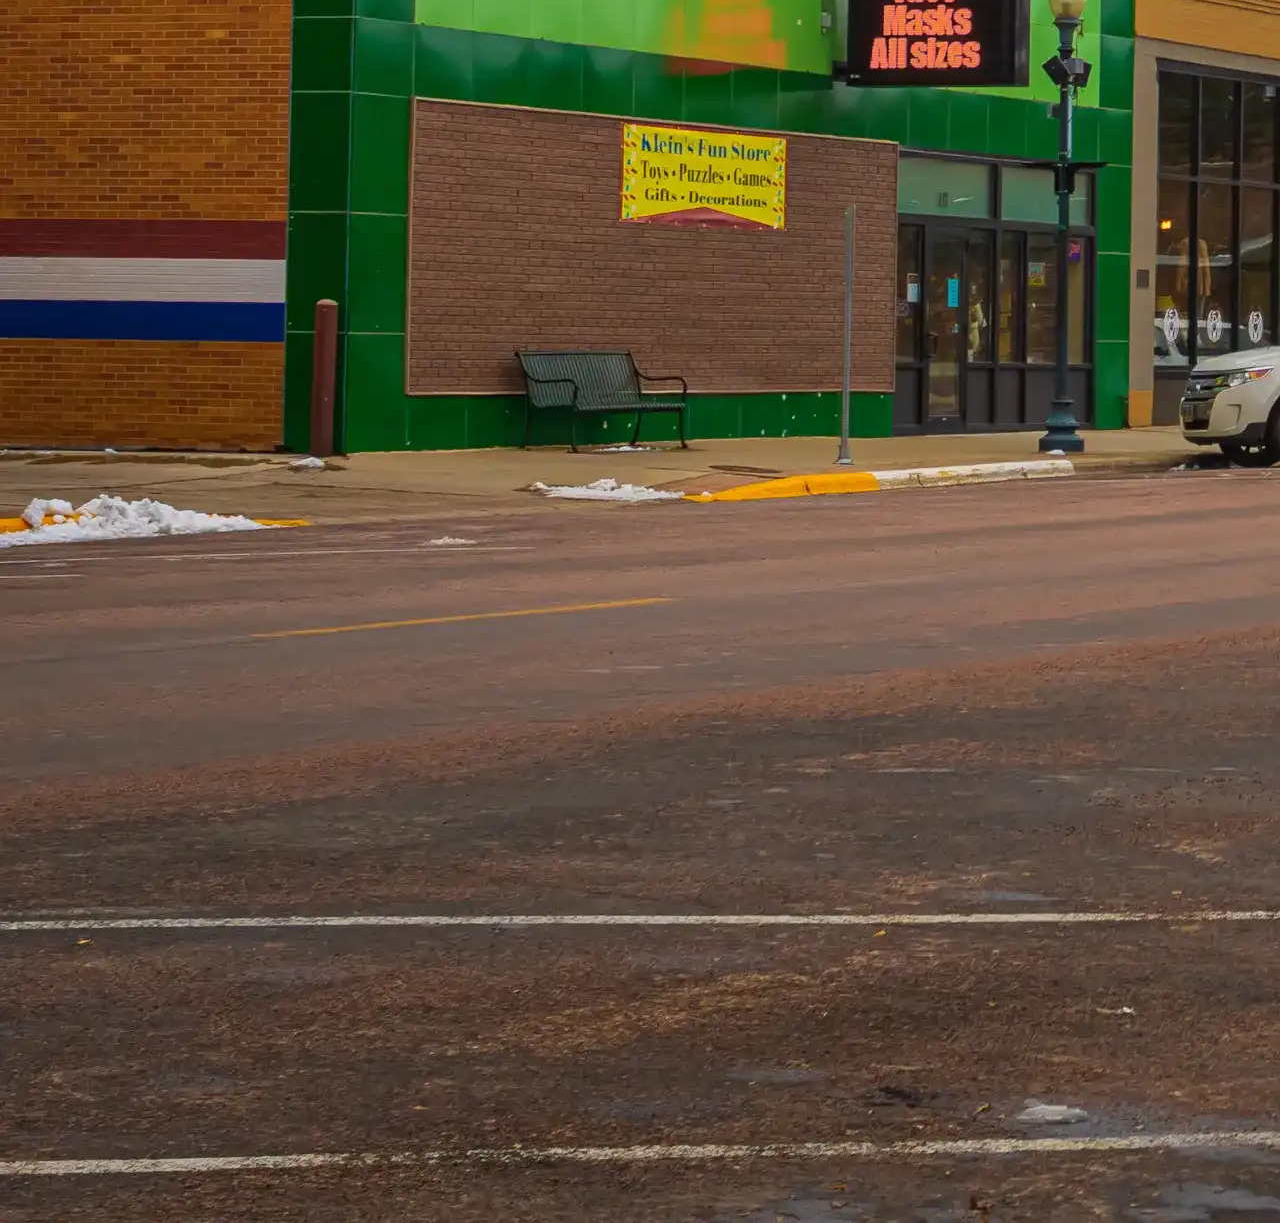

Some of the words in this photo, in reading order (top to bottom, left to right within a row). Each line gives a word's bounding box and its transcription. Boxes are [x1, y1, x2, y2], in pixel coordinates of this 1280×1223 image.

[882, 4, 973, 37] Masks
[869, 37, 908, 69] All
[909, 37, 982, 69] sizes
[641, 133, 694, 156] Klein's
[697, 138, 727, 159] Fun
[731, 140, 771, 162] Store
[640, 159, 669, 185] Toys
[678, 162, 725, 185] Puzzles
[733, 166, 772, 188] Games
[644, 186, 678, 203] Gifts
[688, 190, 768, 208] Decorations
